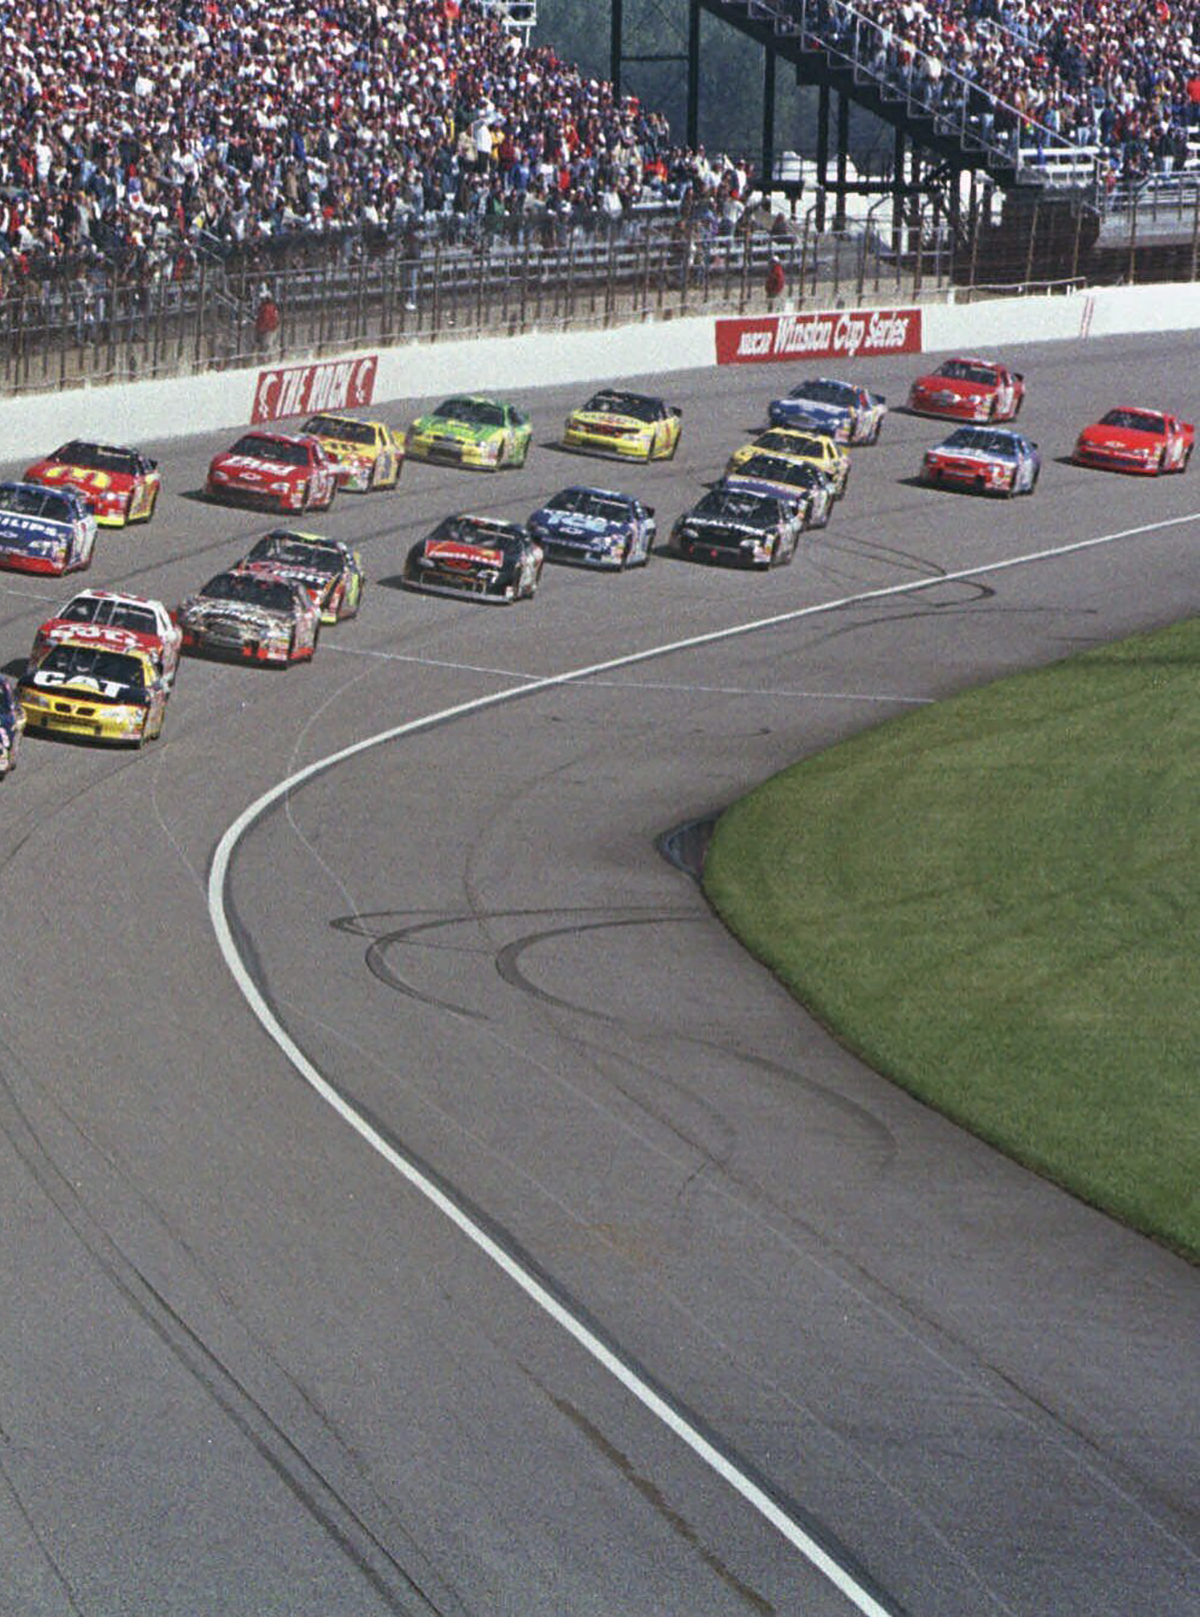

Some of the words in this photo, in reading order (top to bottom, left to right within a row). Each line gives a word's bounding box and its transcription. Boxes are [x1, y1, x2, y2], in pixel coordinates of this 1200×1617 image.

[773, 315, 832, 353] Winston
[833, 314, 865, 357] Cup
[33, 670, 130, 698] CAT
